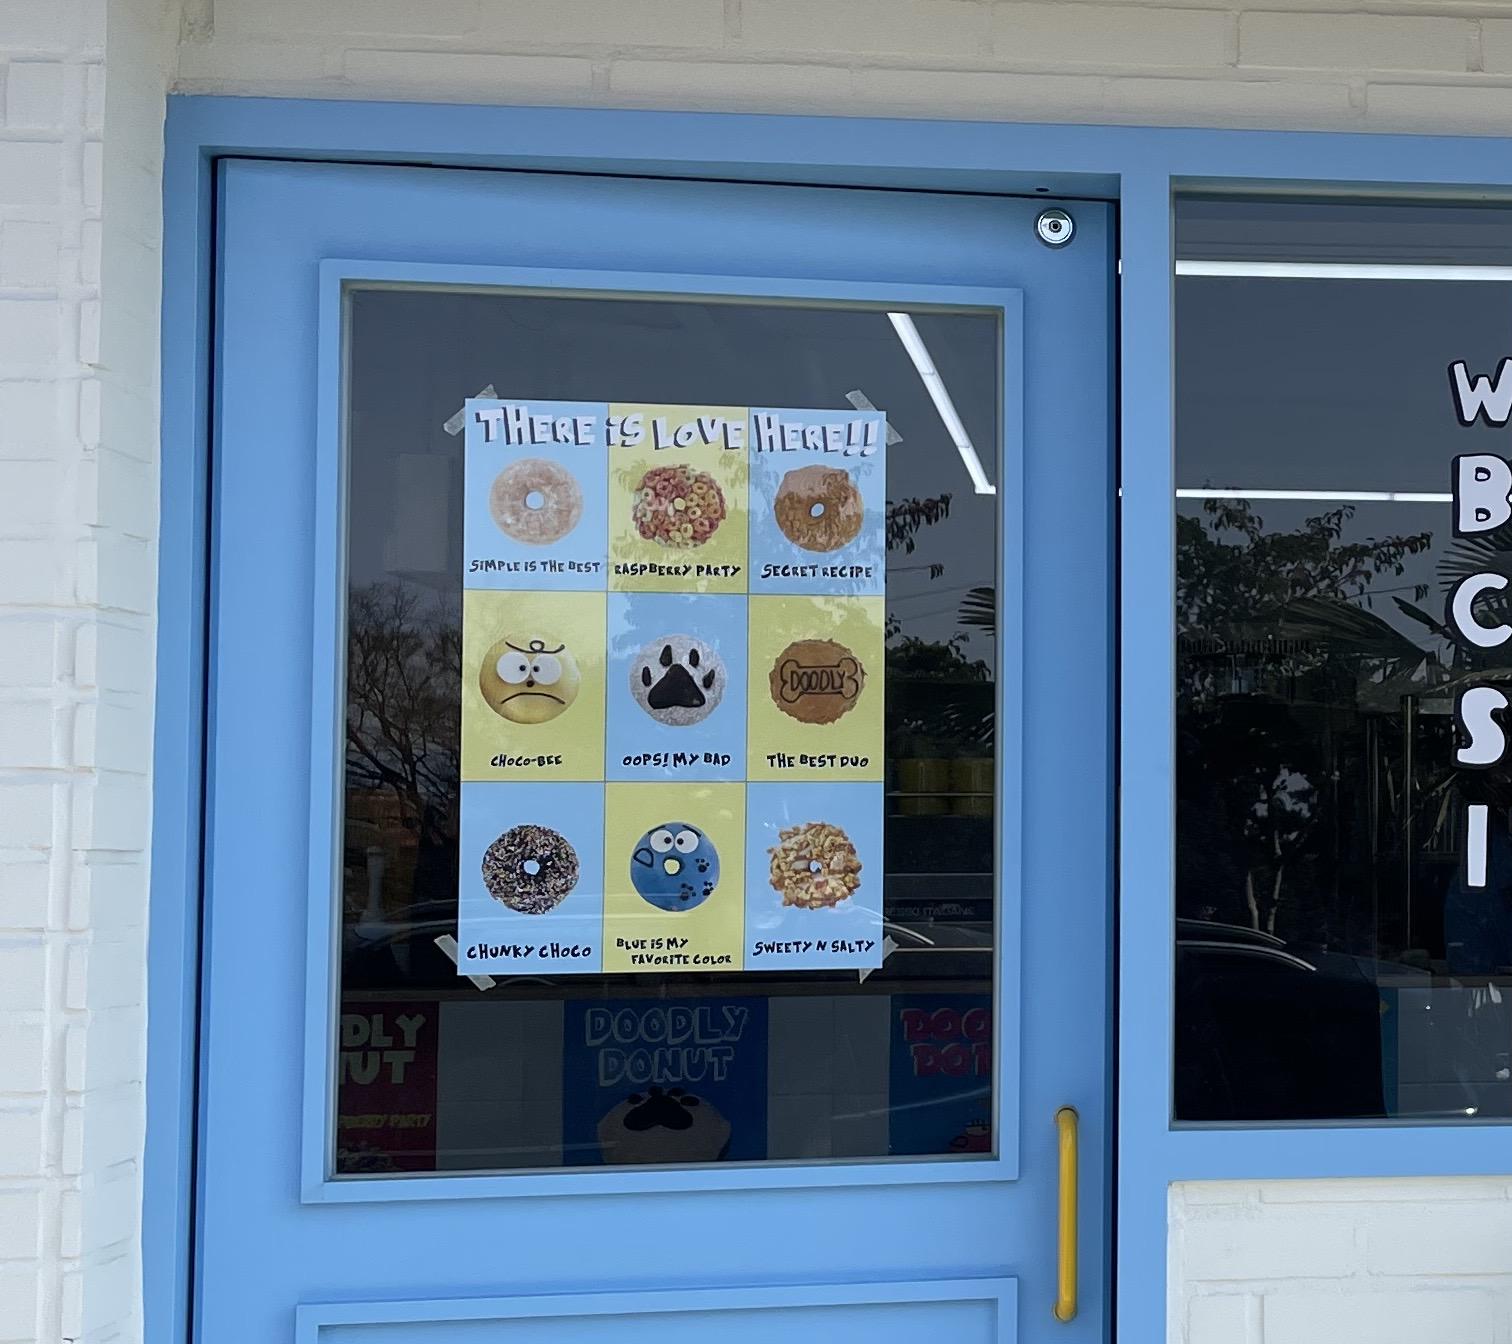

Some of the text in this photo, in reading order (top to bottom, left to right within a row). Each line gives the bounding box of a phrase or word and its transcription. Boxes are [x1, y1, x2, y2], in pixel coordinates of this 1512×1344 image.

[475, 405, 597, 447] THERE
[652, 414, 746, 452] LOVE
[753, 412, 879, 457] HERE!!
[469, 559, 601, 574] SIMPLE IS THE BEST
[614, 563, 741, 578] RASPBERRY PARTY
[761, 563, 819, 579] SECRET
[790, 669, 846, 692] DOODLY
[490, 754, 563, 767] CHOCO-BEE
[622, 752, 731, 768] OOPS! MY BAD
[766, 753, 869, 768] THE BEST DUO
[466, 942, 592, 960] CHUNKY CHOCO
[616, 937, 647, 951] BLUE
[666, 936, 689, 951] MY
[752, 939, 875, 956] SWEETY N SALTY
[692, 953, 732, 965] COLOR
[585, 1005, 750, 1047] DOODLY
[598, 1045, 736, 1087] DONUT
